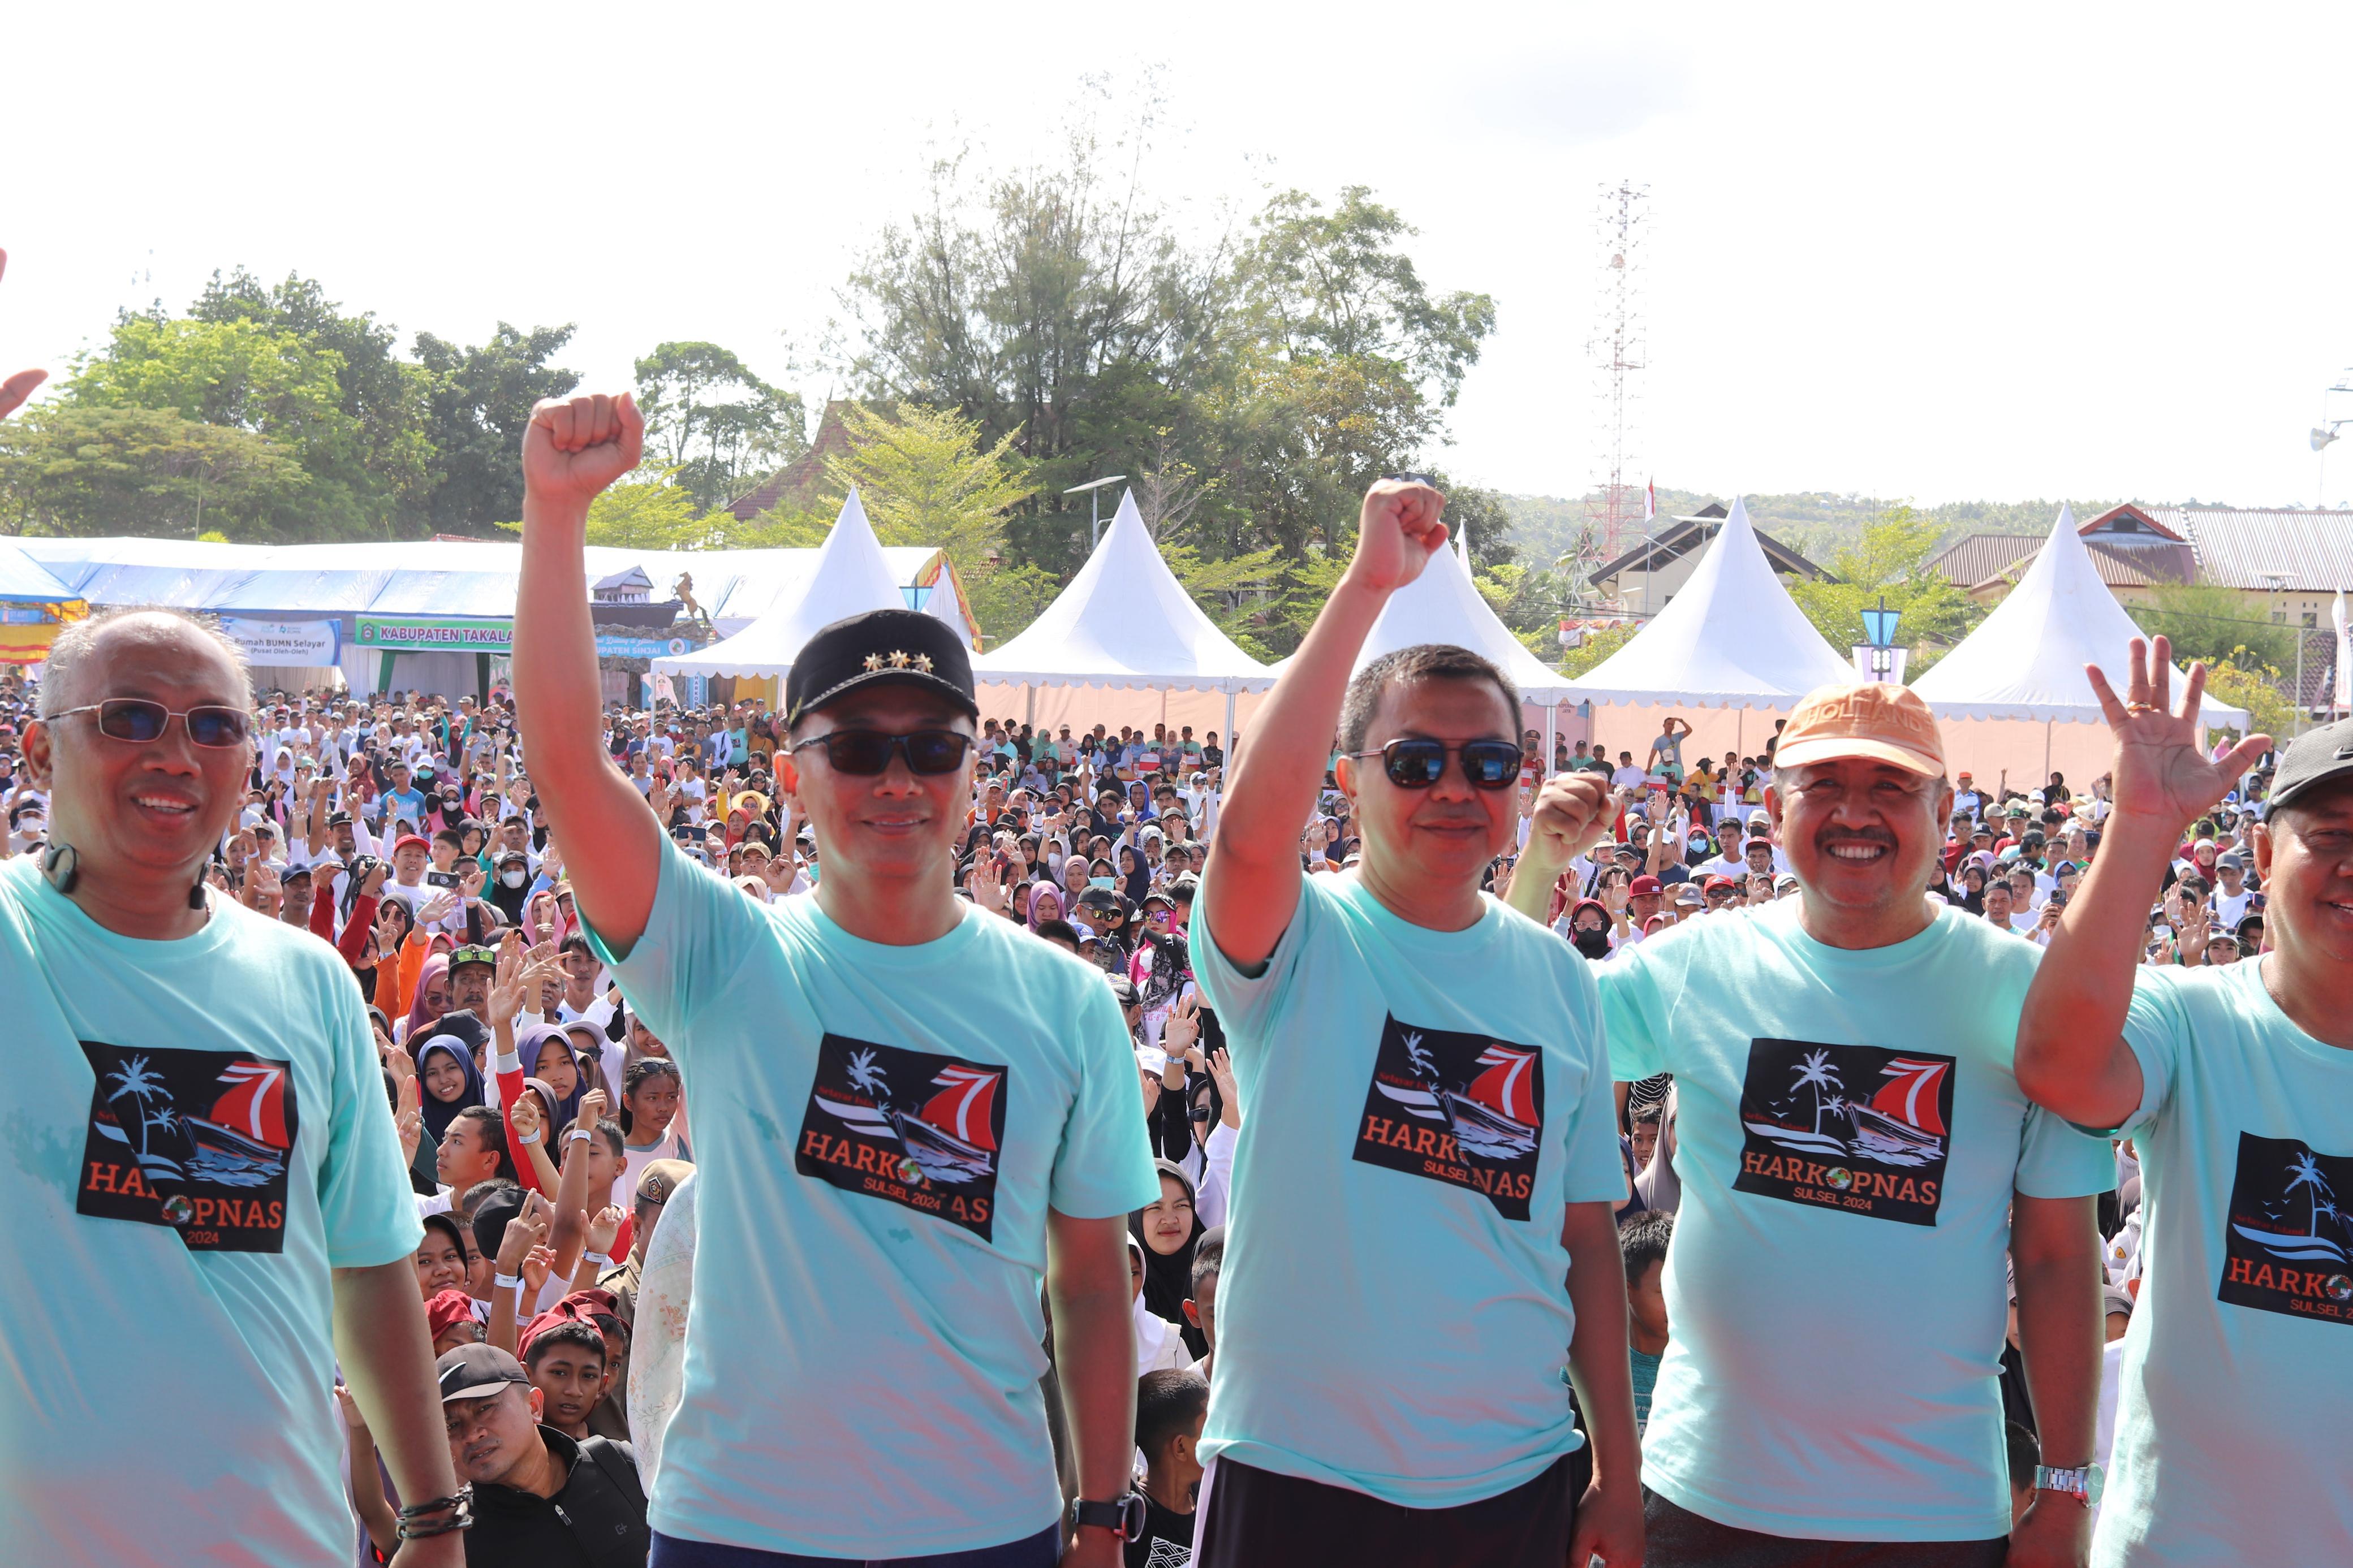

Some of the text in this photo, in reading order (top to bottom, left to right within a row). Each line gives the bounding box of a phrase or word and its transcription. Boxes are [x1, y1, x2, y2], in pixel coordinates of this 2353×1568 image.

[235, 638, 264, 647] Rumah
[294, 640, 326, 649] Selayar
[380, 627, 514, 643] KABUPATEN TAKALA
[1804, 703, 1922, 732] HOLLAND
[1363, 1115, 1531, 1199] HARKNAS
[1424, 1160, 1471, 1183] SULSEL
[863, 1177, 941, 1211] SULSEL 2024
[1794, 1186, 1873, 1211] SULSEL 2024
[186, 1231, 219, 1244] 2024
[2228, 1256, 2353, 1301] HARKO
[2290, 1298, 2342, 1318] SULSEL
